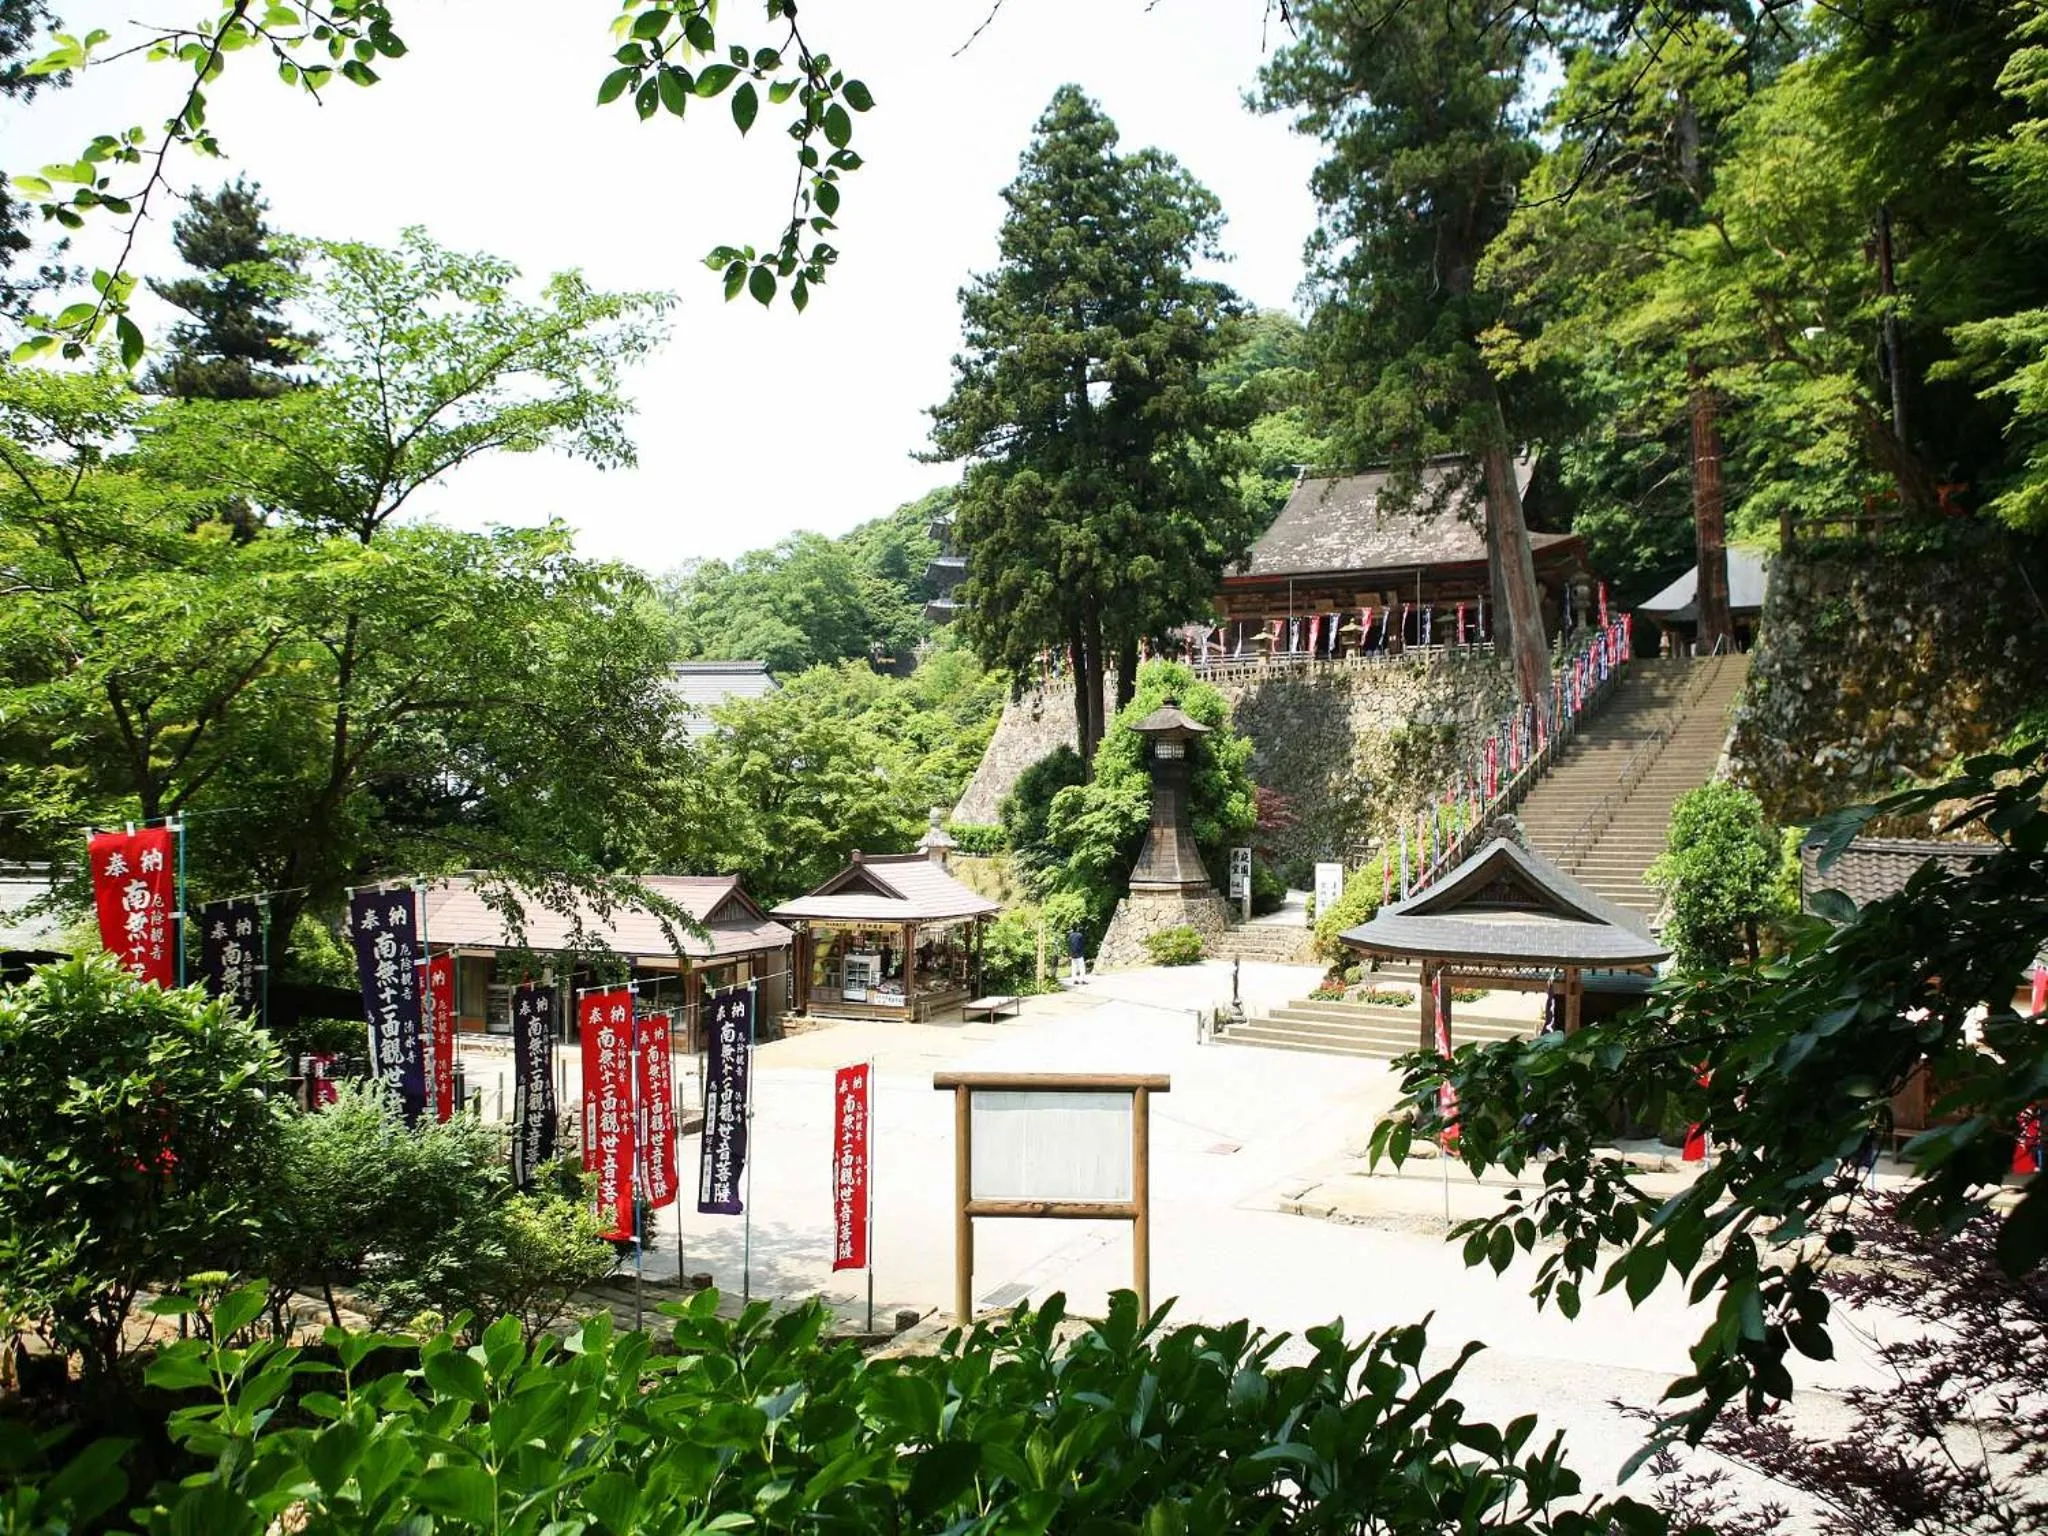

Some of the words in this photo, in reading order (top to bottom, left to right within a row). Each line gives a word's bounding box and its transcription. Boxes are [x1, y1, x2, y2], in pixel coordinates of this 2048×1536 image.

[104, 848, 164, 878] 奉納
[210, 917, 252, 939] 奉納
[360, 905, 408, 931] 奉納
[519, 996, 549, 1016] 奉納
[588, 1005, 626, 1025] 奉納
[716, 1001, 745, 1022] 奉納
[373, 931, 407, 1120] 南無十一面観世音
[639, 1026, 665, 1045] 奉納
